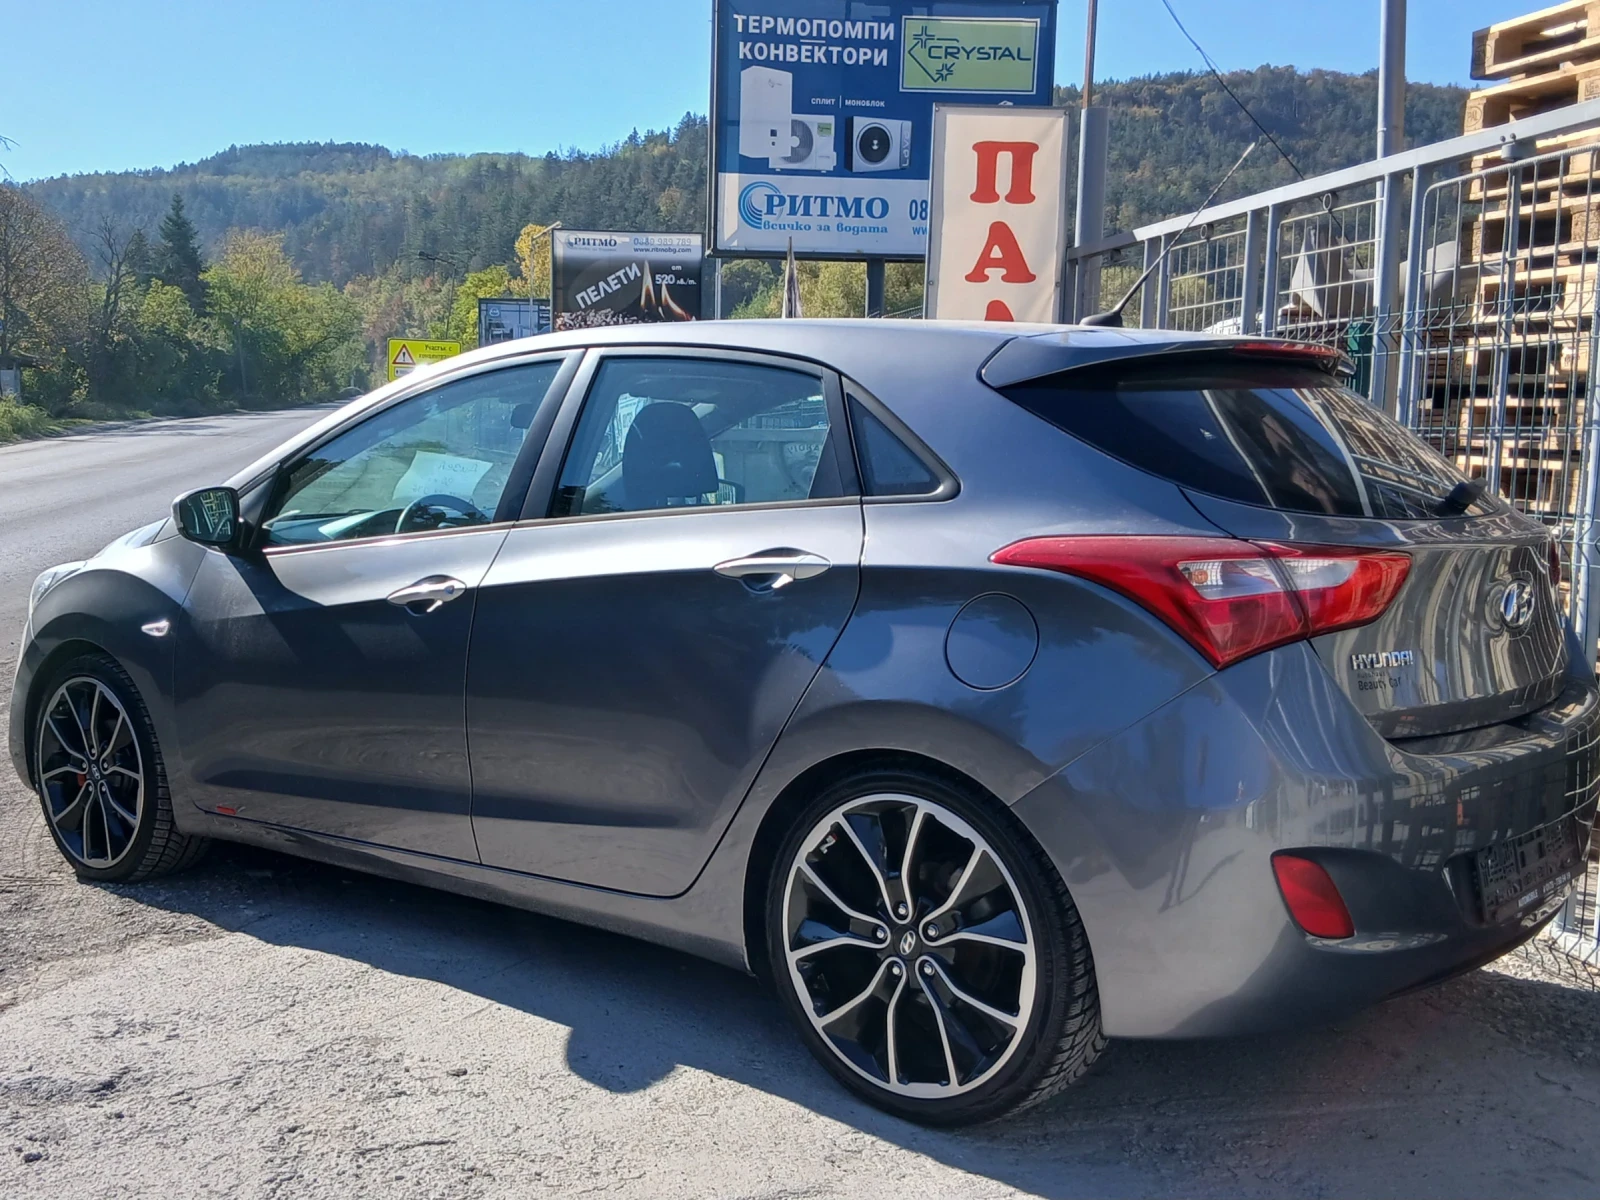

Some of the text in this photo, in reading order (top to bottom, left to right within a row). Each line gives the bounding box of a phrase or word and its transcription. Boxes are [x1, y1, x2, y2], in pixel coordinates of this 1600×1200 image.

[733, 14, 895, 41] ТЕРМОПОМПИ
[738, 41, 888, 67] КОНВЕКТОРИ
[927, 45, 1032, 61] CRYSTAL
[763, 193, 890, 219] РИТМО
[763, 221, 888, 235] всичко за водата
[574, 237, 617, 247] РИТМО
[575, 262, 641, 309] ПЕЛЕТИ
[655, 274, 675, 284] 520
[1351, 650, 1414, 670] HYUNDAI
[1358, 679, 1387, 691] Beauty
